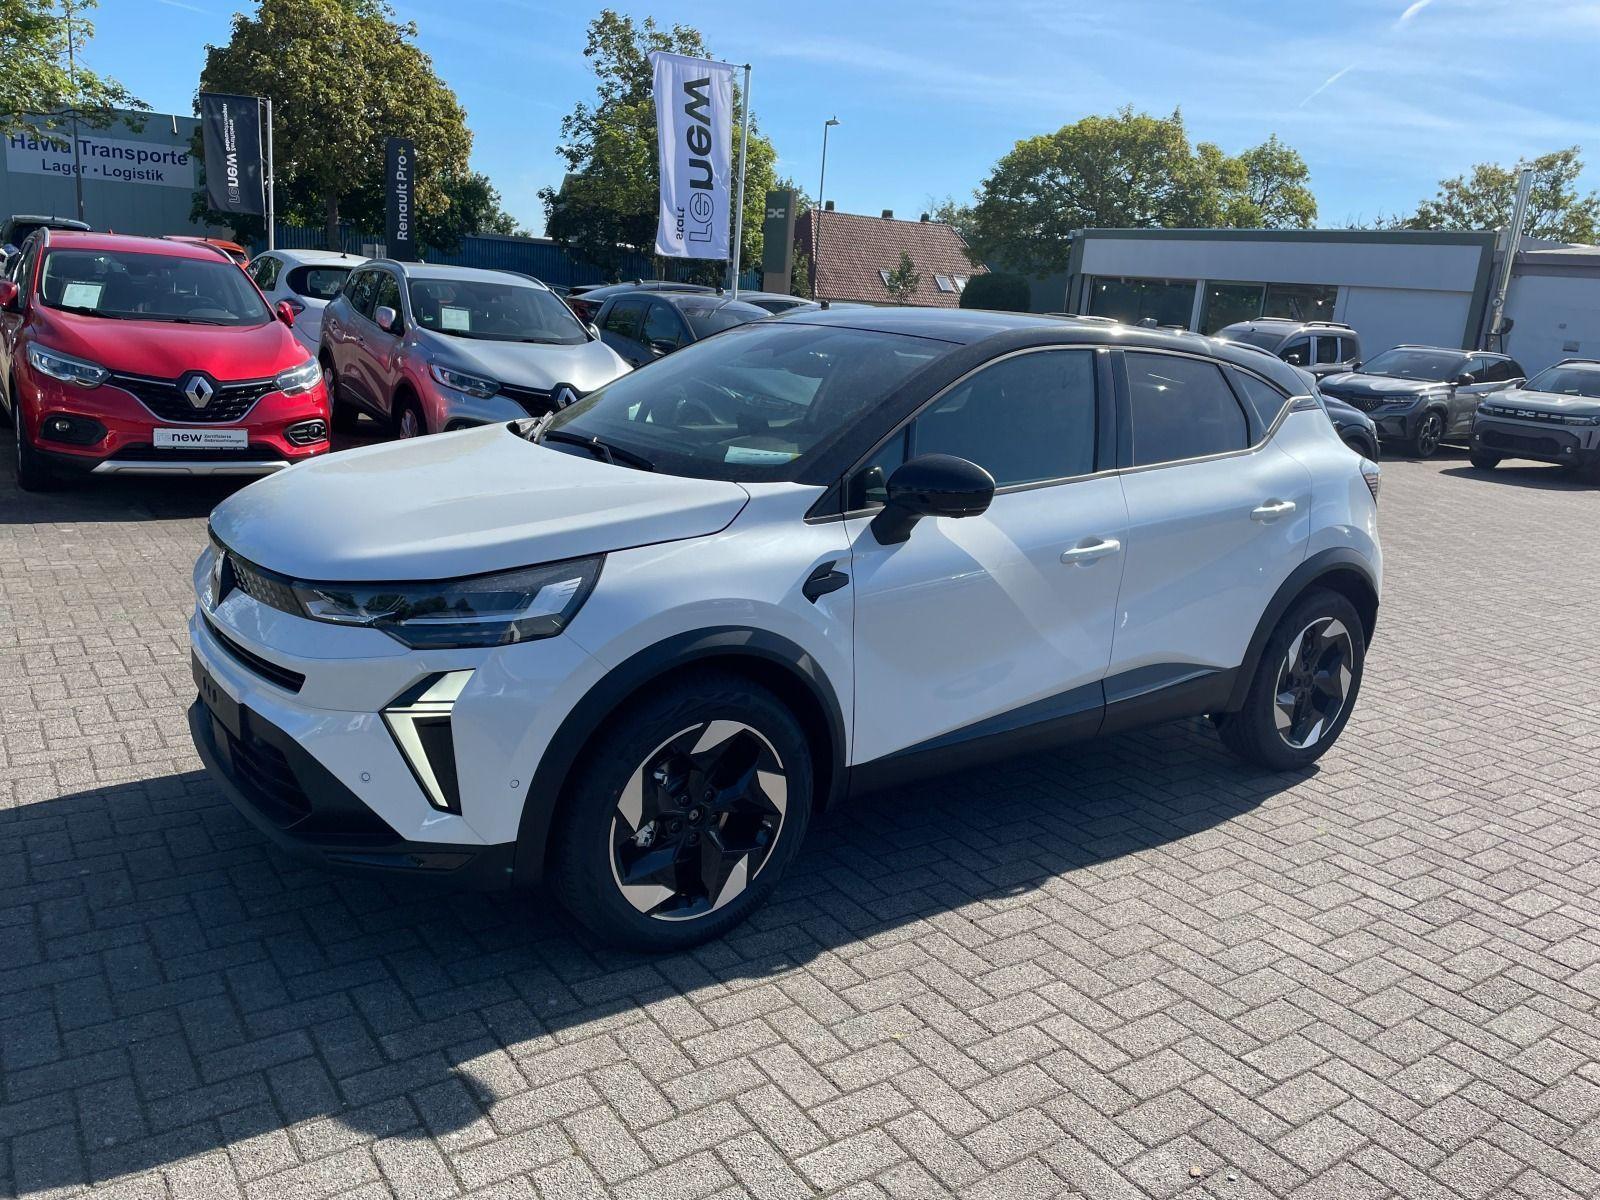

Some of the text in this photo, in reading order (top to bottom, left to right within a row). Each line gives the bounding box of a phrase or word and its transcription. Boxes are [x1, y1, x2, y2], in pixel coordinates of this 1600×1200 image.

[78, 139, 188, 166] Transporte
[42, 158, 164, 182] Lager Logistik
[396, 146, 408, 241] Renault Pro+
